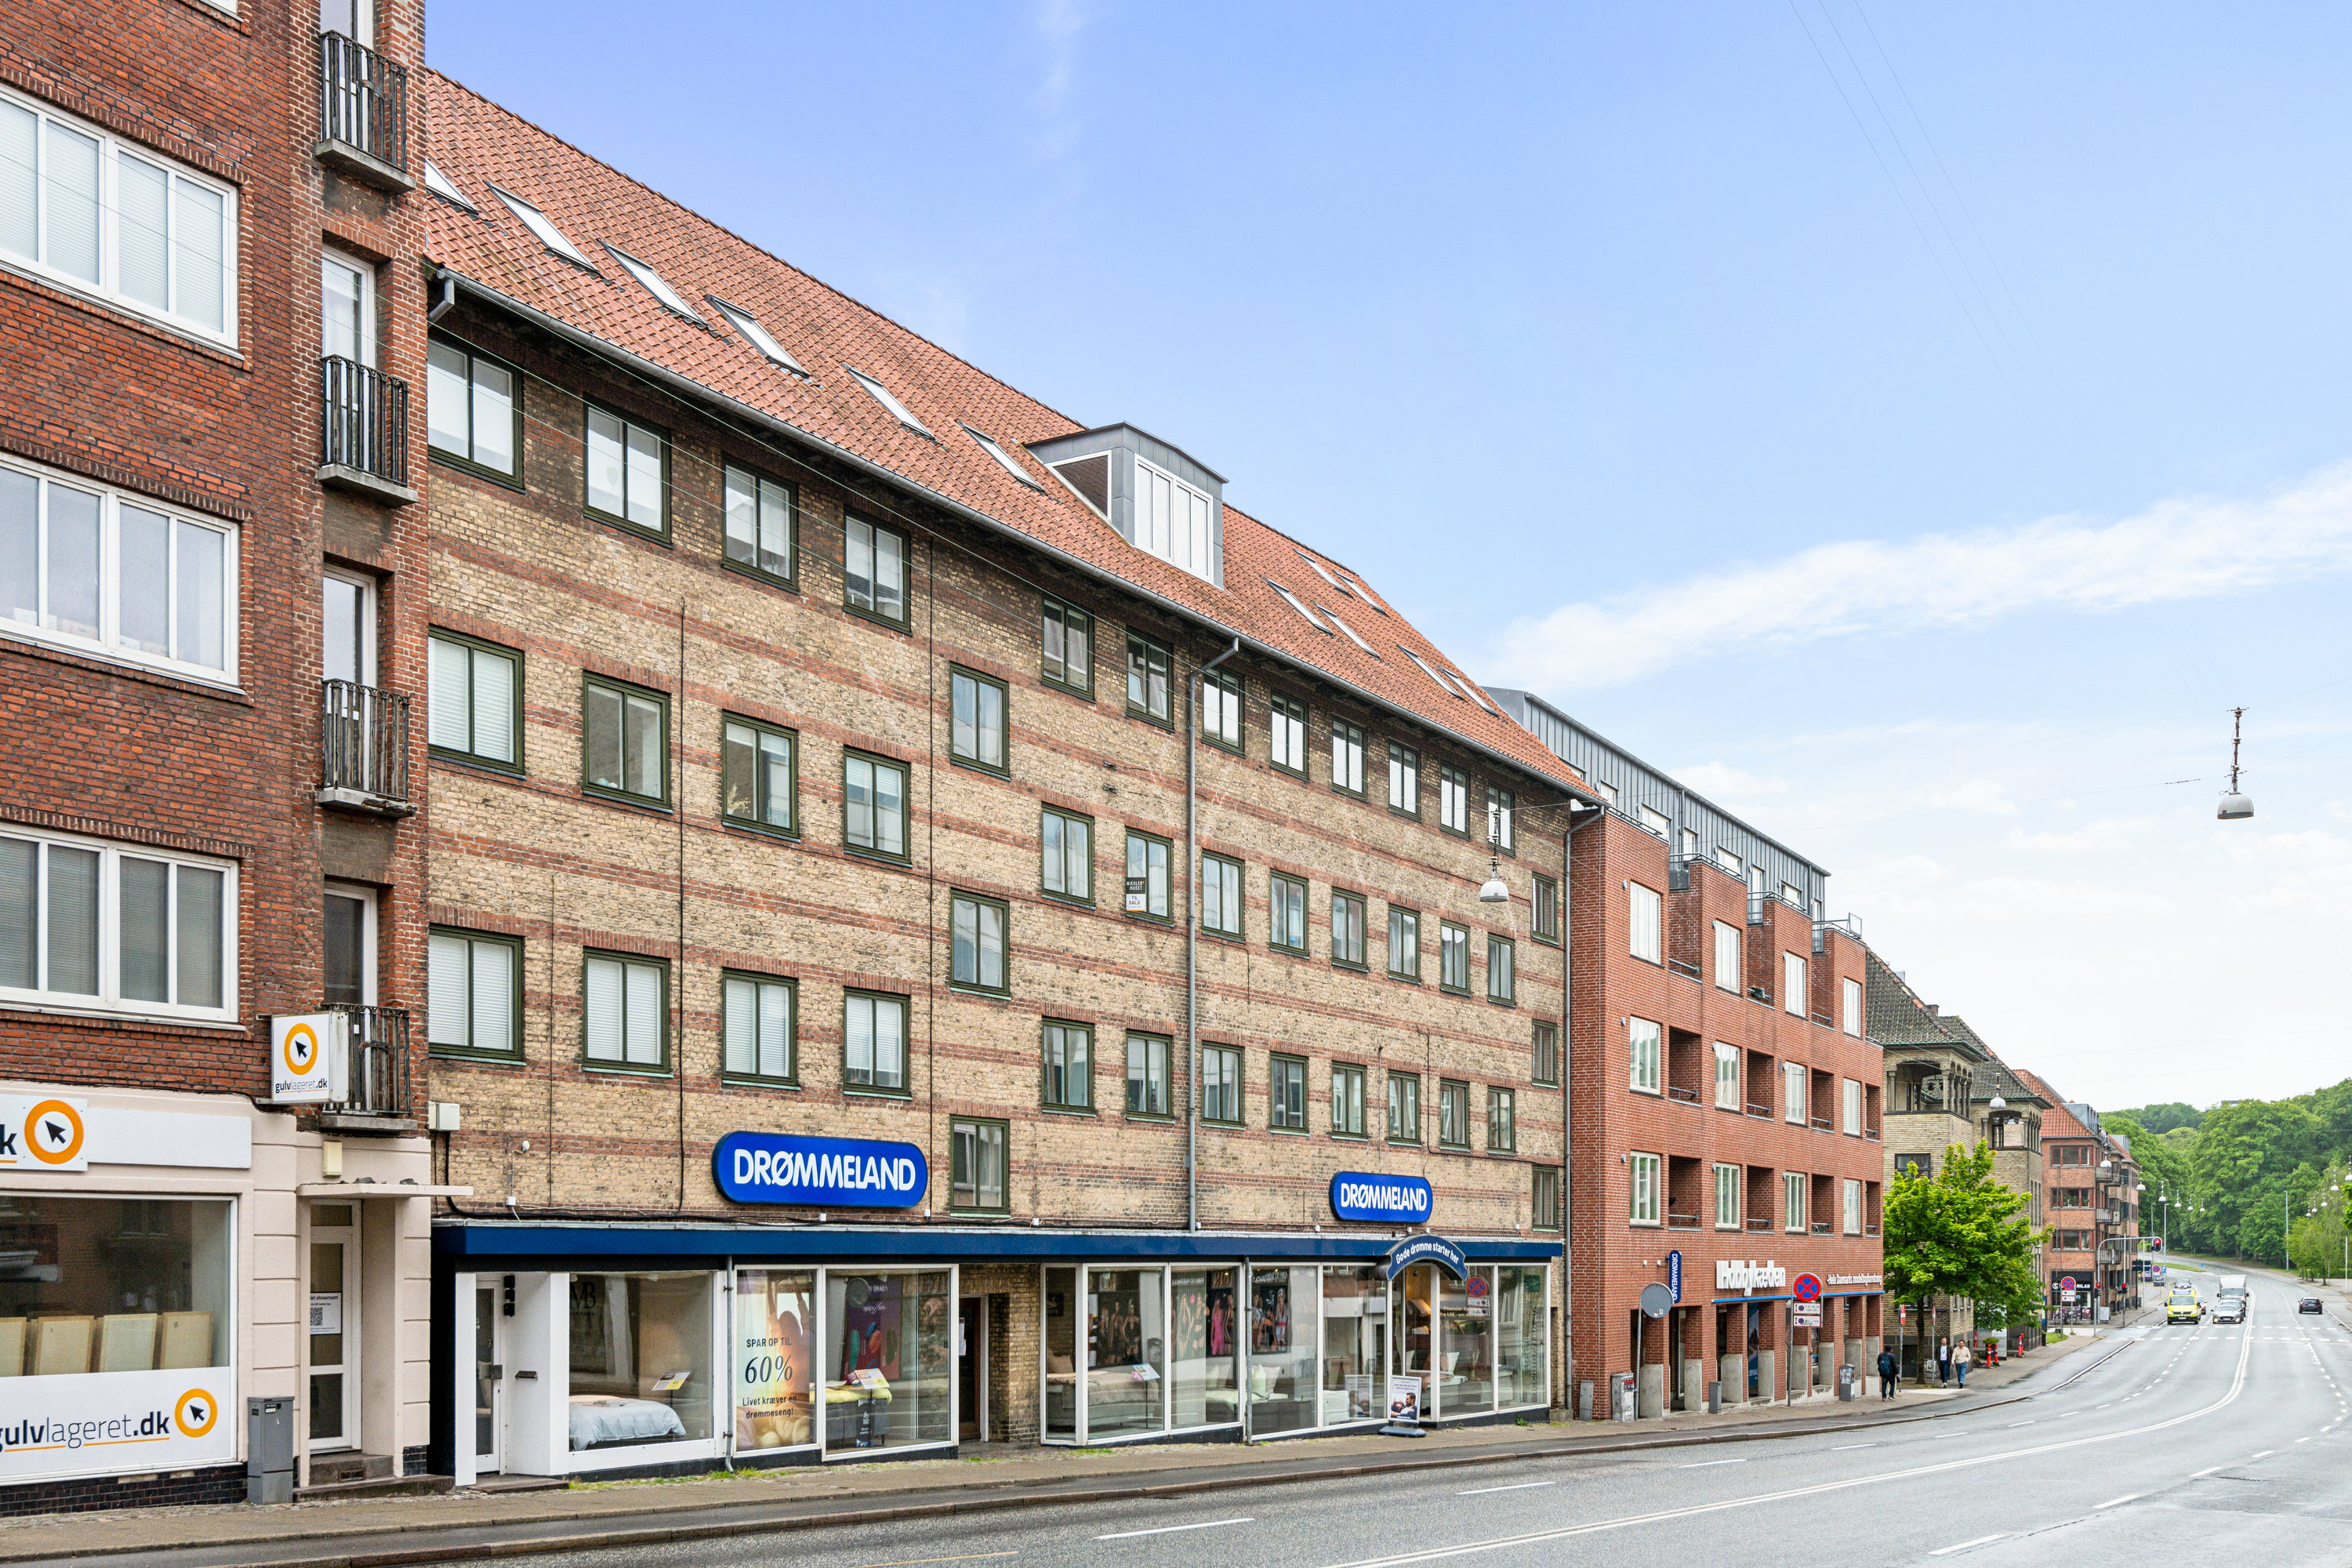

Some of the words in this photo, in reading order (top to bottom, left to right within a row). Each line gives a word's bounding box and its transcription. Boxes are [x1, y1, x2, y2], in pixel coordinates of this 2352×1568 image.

[275, 1078, 328, 1094] gulvlageret.dk
[734, 1149, 916, 1191] DRØMMELAND
[1341, 1182, 1428, 1211] DRØMMELAND
[1396, 1248, 1410, 1265] Gode
[1410, 1243, 1432, 1255] drømme
[1432, 1242, 1450, 1258] starter
[1450, 1249, 1460, 1264] her
[1716, 1259, 1786, 1296] Hobbykæden
[746, 1338, 766, 1348] SPAR
[768, 1338, 779, 1346] OP
[780, 1337, 791, 1346] TIL
[745, 1355, 793, 1384] 60%
[742, 1397, 760, 1406] Livet
[762, 1396, 786, 1405] kræver
[746, 1408, 793, 1419] drømmeseng!
[0, 1410, 170, 1453] ulvlageret.dk
